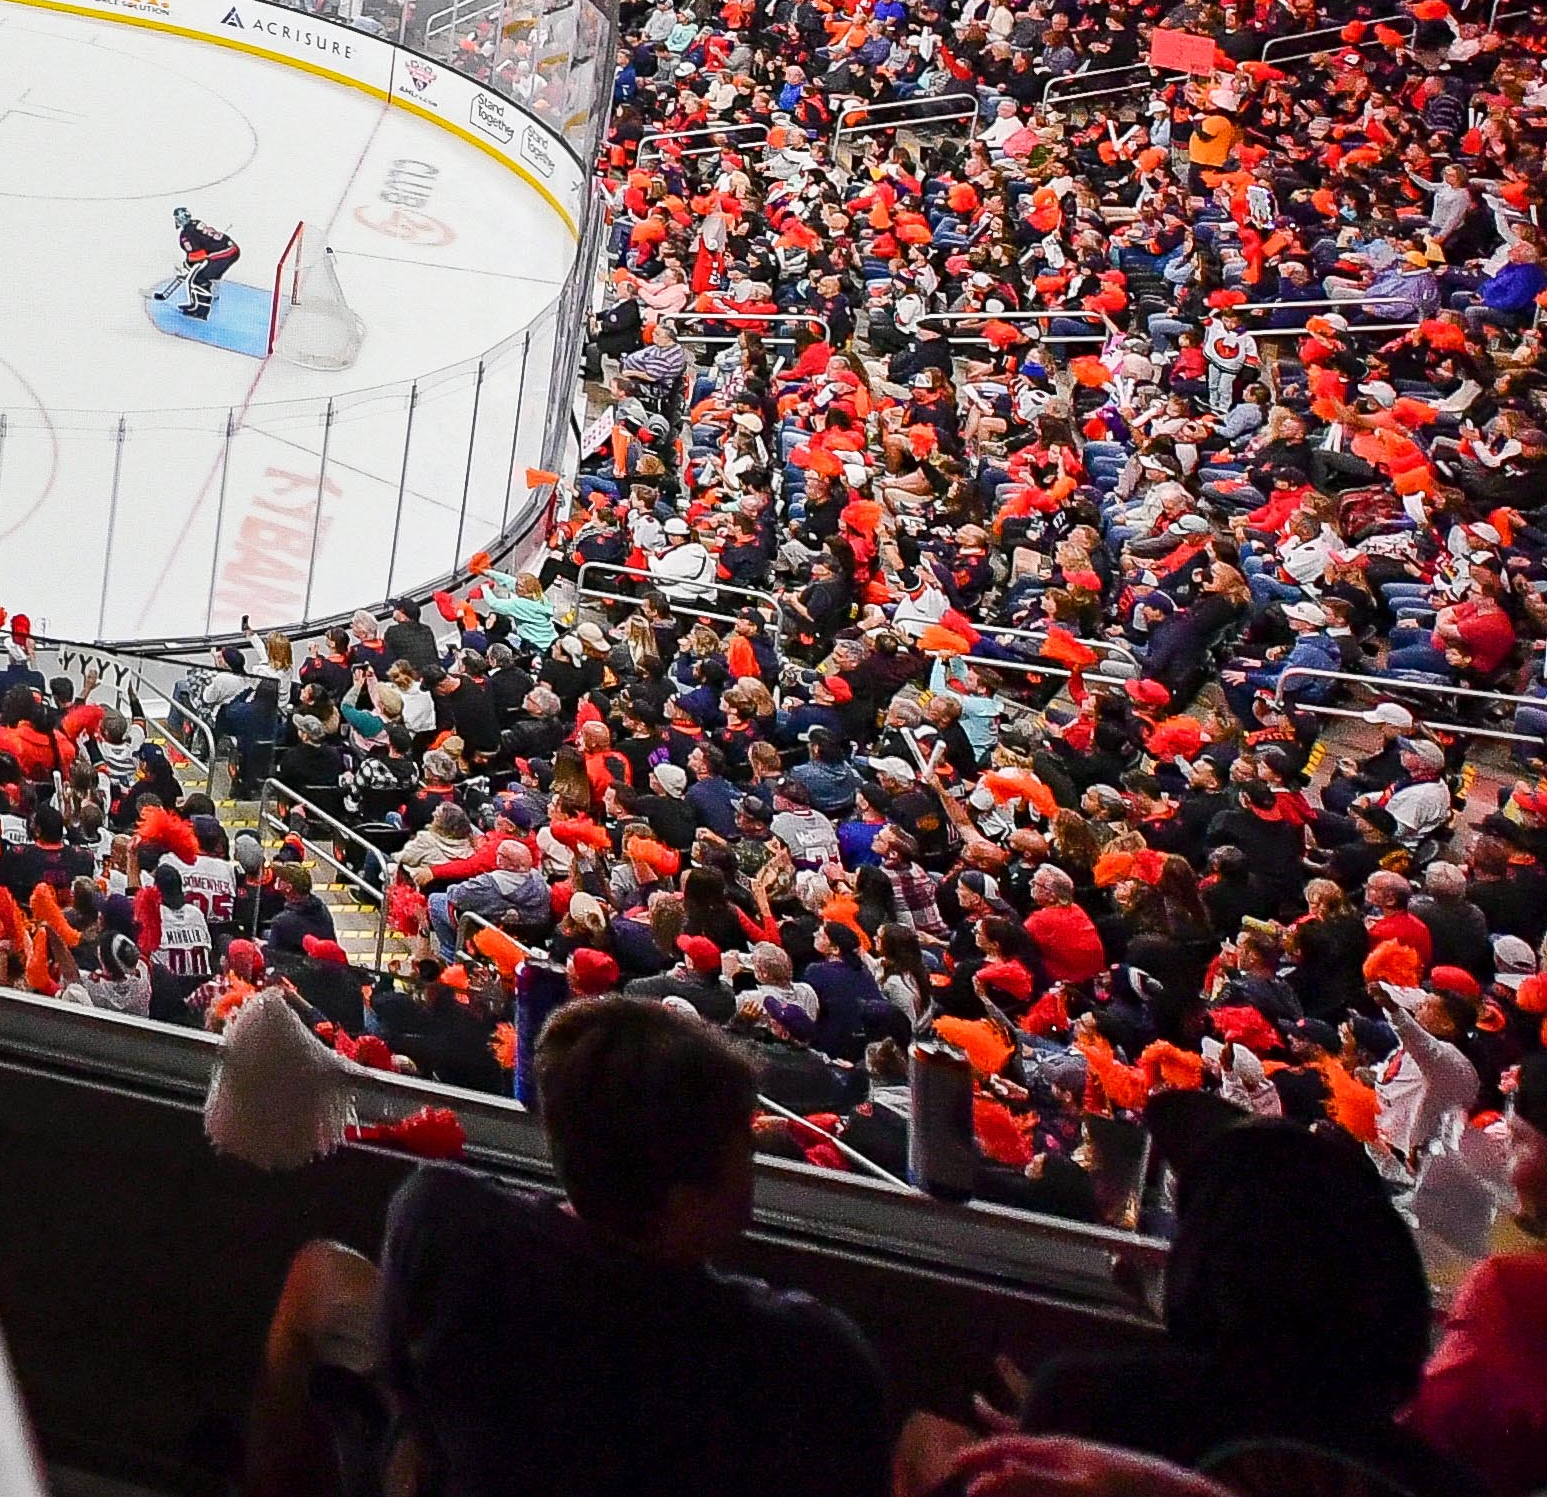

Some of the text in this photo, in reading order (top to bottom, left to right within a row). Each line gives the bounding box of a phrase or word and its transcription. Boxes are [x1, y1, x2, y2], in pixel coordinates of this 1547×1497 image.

[121, 1, 171, 16] SOLUTION
[252, 18, 353, 59] ACRISURE
[477, 92, 505, 117] Stand
[527, 125, 549, 150] Stand
